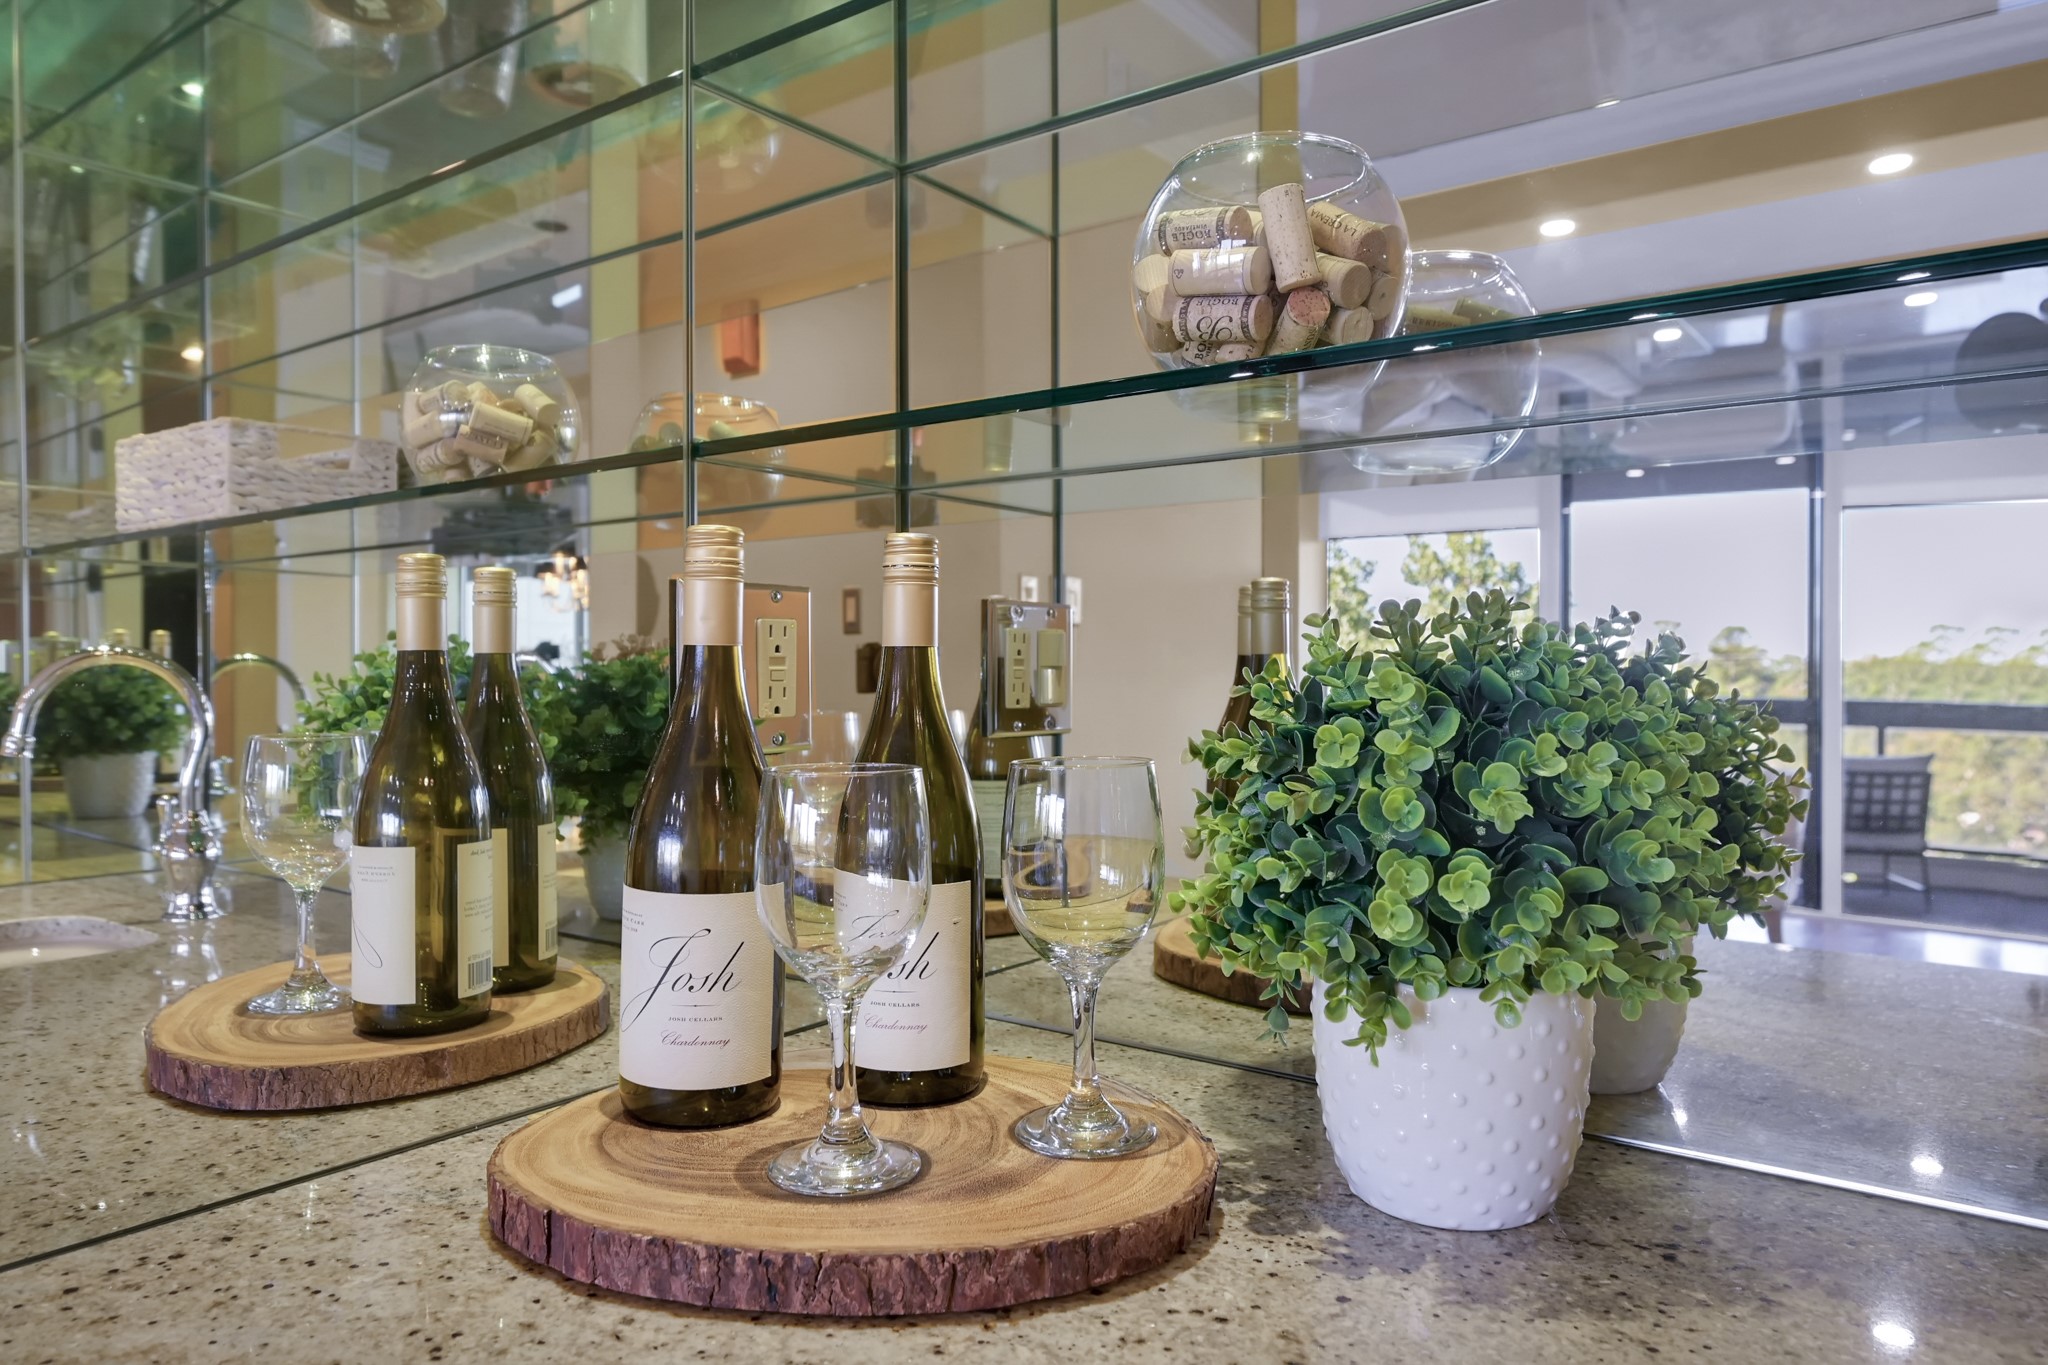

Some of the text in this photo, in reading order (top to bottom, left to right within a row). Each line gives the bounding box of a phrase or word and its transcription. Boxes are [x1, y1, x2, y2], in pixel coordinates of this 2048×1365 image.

[1310, 208, 1358, 237] LA CREMA
[1171, 229, 1212, 242] BOGLE
[620, 928, 745, 1033] Josh
[863, 1012, 928, 1034] Chardonnay
[660, 1029, 731, 1050] Chardonnay
